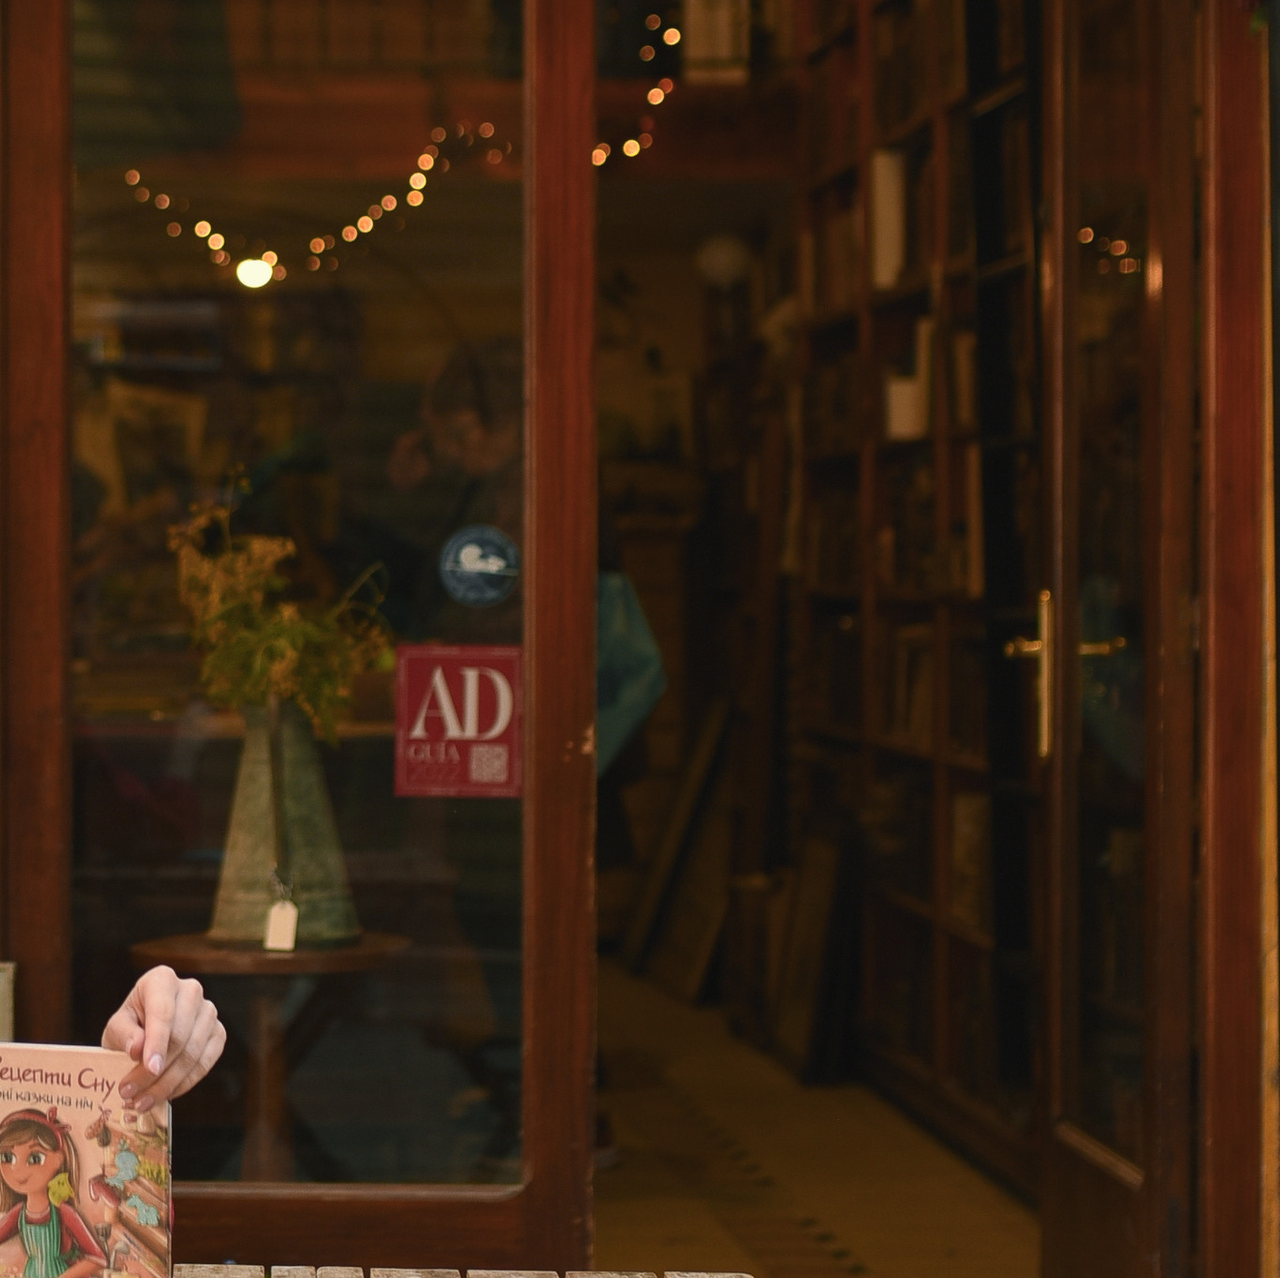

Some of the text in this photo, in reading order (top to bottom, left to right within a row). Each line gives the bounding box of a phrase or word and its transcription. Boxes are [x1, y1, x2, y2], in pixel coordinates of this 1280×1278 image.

[408, 665, 514, 741] AD
[15, 1090, 54, 1104] казки
[56, 1094, 72, 1107] на
[75, 1096, 94, 1110] ніч
[77, 1067, 116, 1103] Сну
